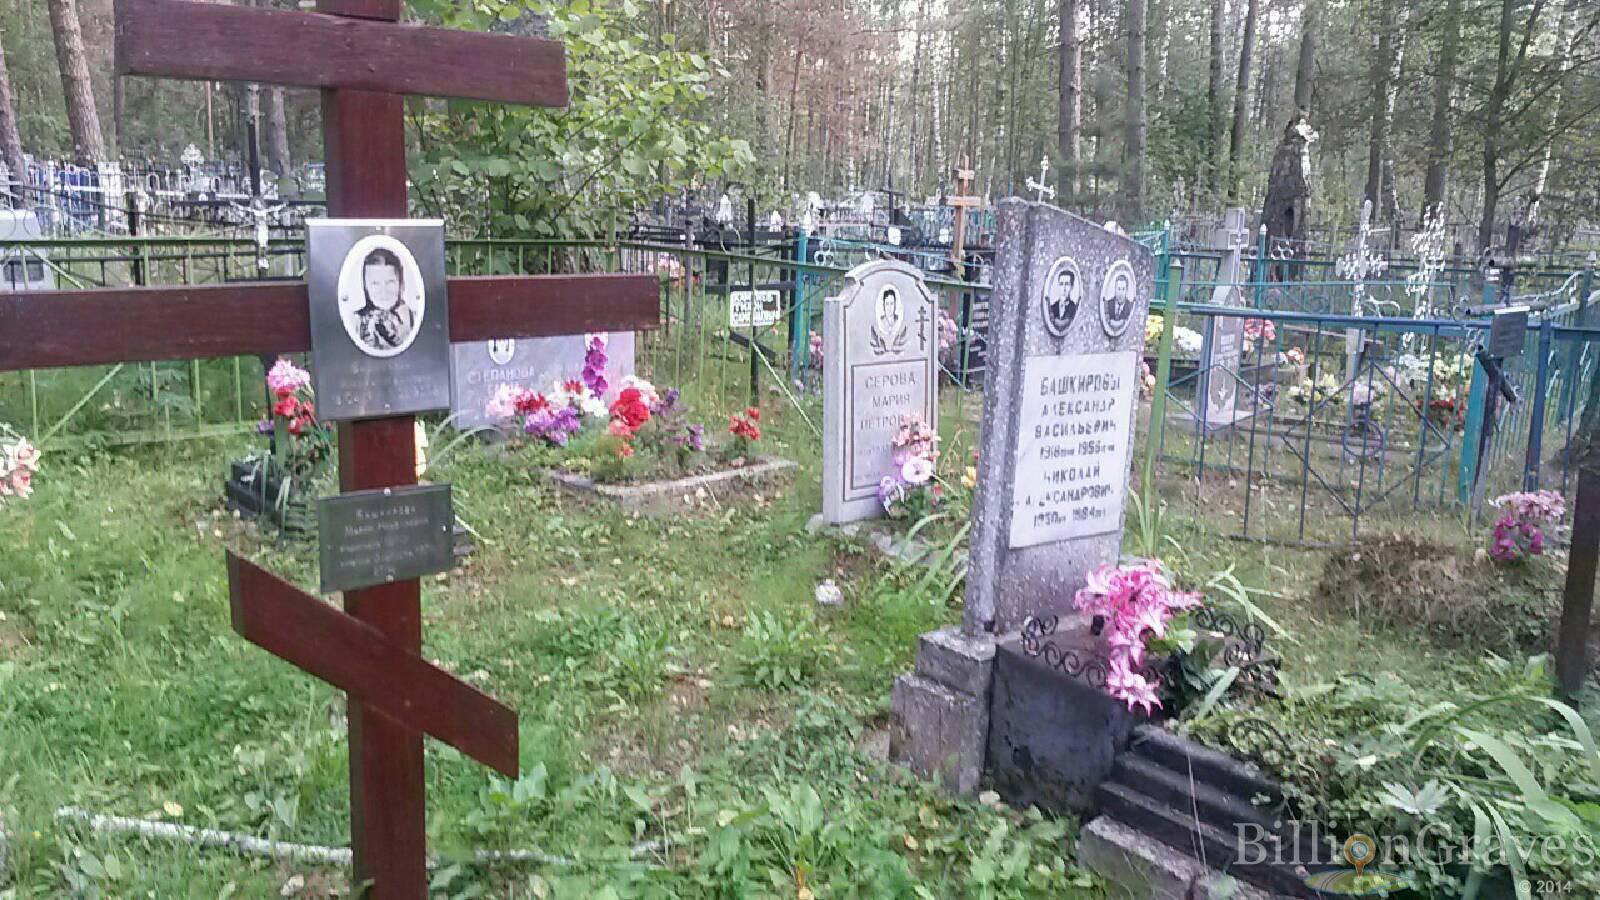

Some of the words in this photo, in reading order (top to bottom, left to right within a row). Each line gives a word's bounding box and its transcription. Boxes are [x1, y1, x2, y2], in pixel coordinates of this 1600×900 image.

[864, 370, 916, 389] СЕРОВА
[1039, 373, 1121, 397] БАШКИРОВЫ
[872, 392, 910, 408] МАРИЯ
[860, 414, 906, 431] ПЕТРОВ
[1034, 419, 1117, 440] ВАСИЛЬЕВИЧ
